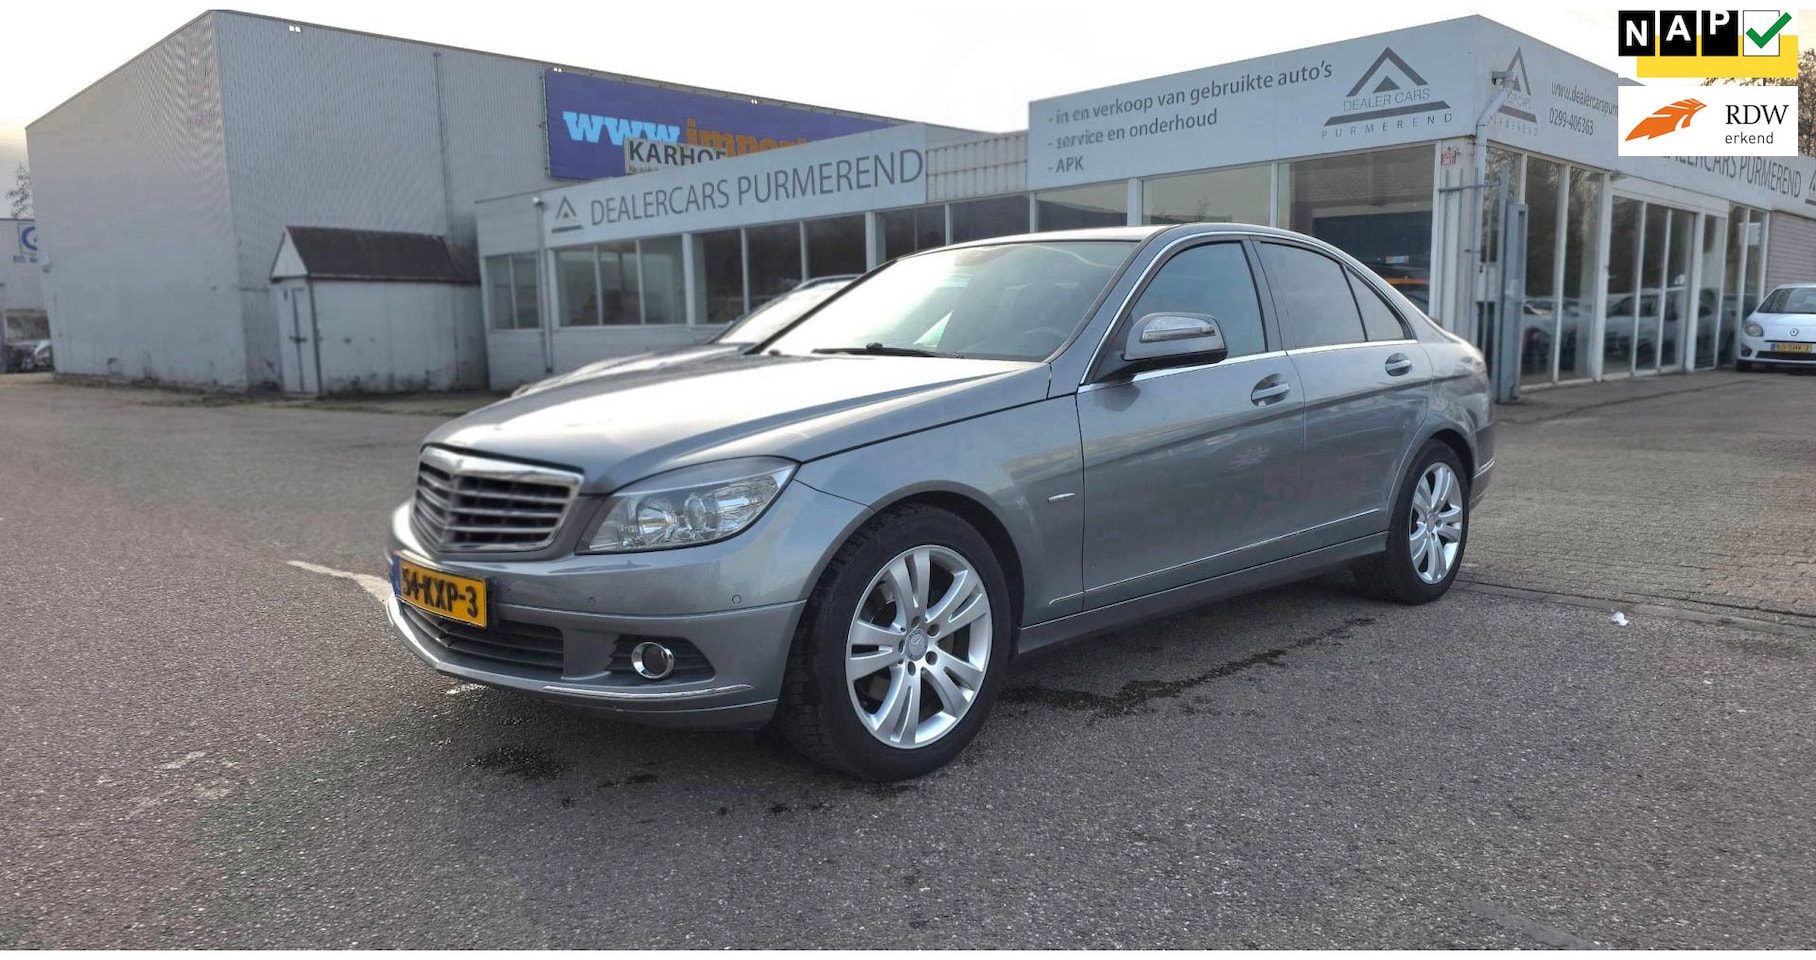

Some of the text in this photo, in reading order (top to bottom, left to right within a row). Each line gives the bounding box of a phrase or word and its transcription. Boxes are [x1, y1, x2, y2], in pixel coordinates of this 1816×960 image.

[1056, 109, 1069, 124] in
[1072, 108, 1089, 121] en
[1093, 98, 1153, 118] verkoop
[1158, 90, 1185, 106] van
[1190, 73, 1274, 105] gebruikte
[1278, 60, 1332, 86] auto's
[1343, 87, 1430, 113] DEALER CARS
[1056, 130, 1104, 149] service
[1107, 127, 1125, 141] en
[1129, 108, 1217, 138] onderhoud
[1322, 113, 1453, 139] PURMEREND
[1055, 155, 1084, 173] APK
[1739, 156, 1802, 198] PURMEREND
[591, 148, 924, 227] DEALERCARS PURMEREND
[401, 566, 478, 618] 54-KXP-3
